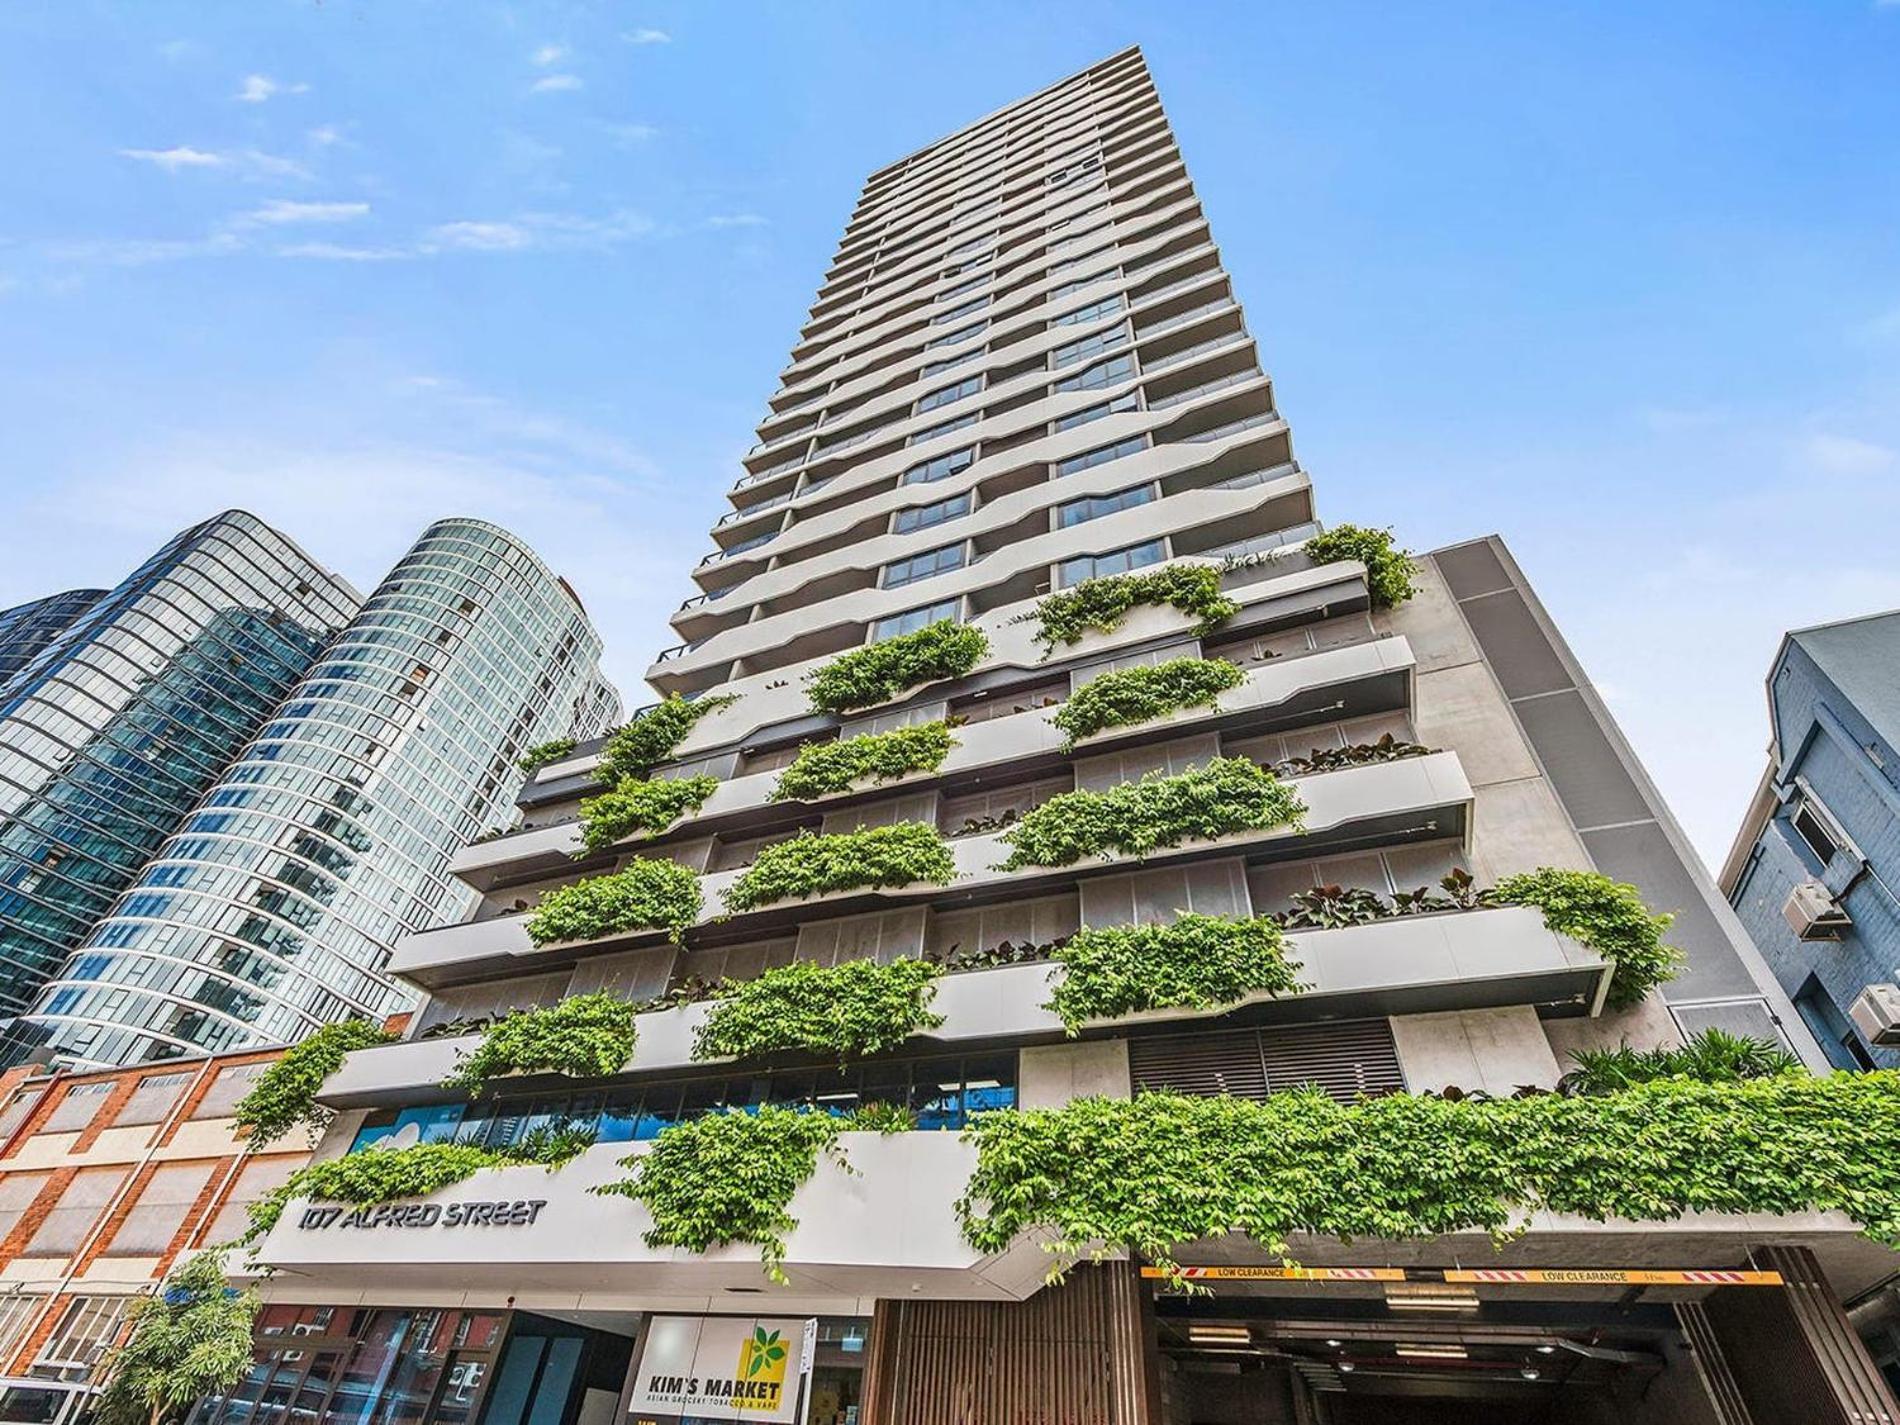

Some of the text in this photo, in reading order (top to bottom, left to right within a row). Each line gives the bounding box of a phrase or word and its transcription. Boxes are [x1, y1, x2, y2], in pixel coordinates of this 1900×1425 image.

[299, 1200, 547, 1230] 107 ALFRED STREET
[1218, 1268, 1285, 1277] LOW CLEARANCE
[1542, 1272, 1627, 1282] LOW CLEARANCE
[649, 1376, 780, 1399] KIM'S MARKET
[646, 1394, 669, 1403] ASIAN
[671, 1396, 706, 1405] GROCERY
[708, 1398, 745, 1408] TOBACCO
